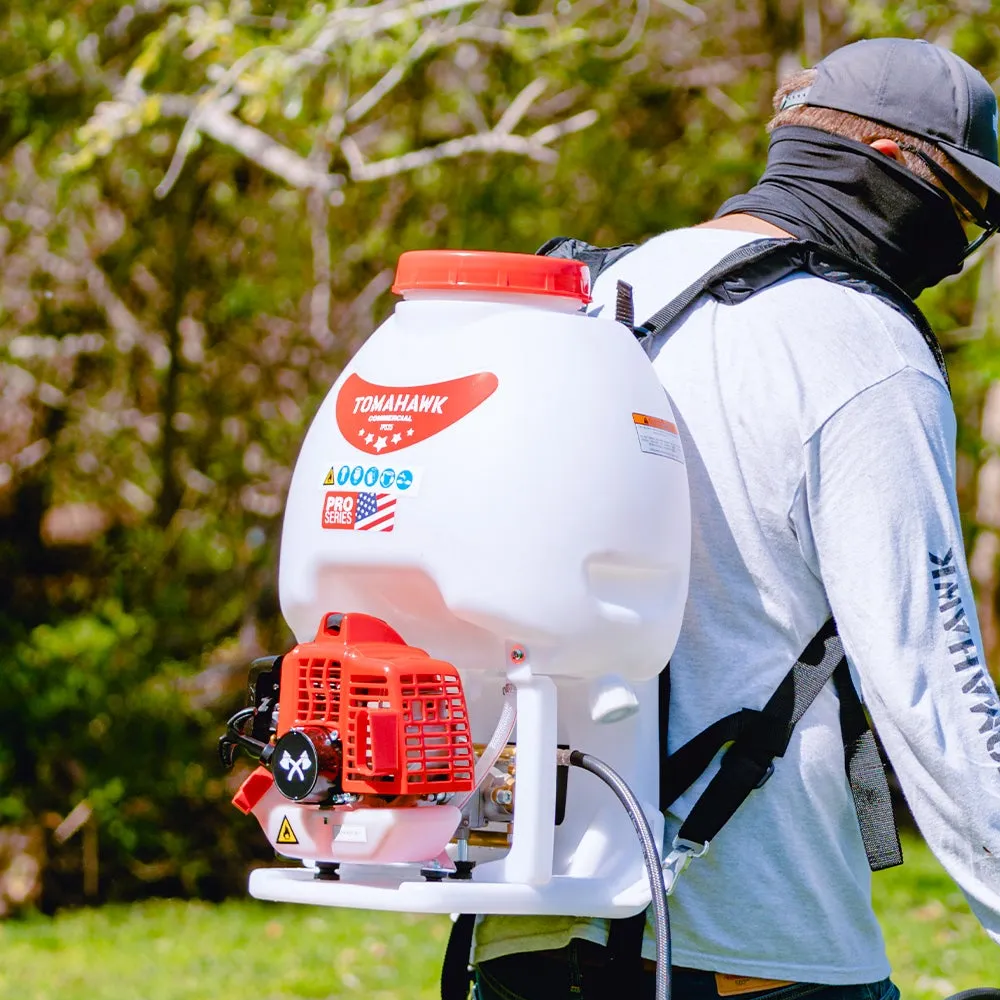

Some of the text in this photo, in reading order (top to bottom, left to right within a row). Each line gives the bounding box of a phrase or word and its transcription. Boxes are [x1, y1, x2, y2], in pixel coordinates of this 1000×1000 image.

[353, 394, 448, 414] TOMAHAWK
[326, 496, 353, 511] PRO
[325, 511, 352, 524] SERIES
